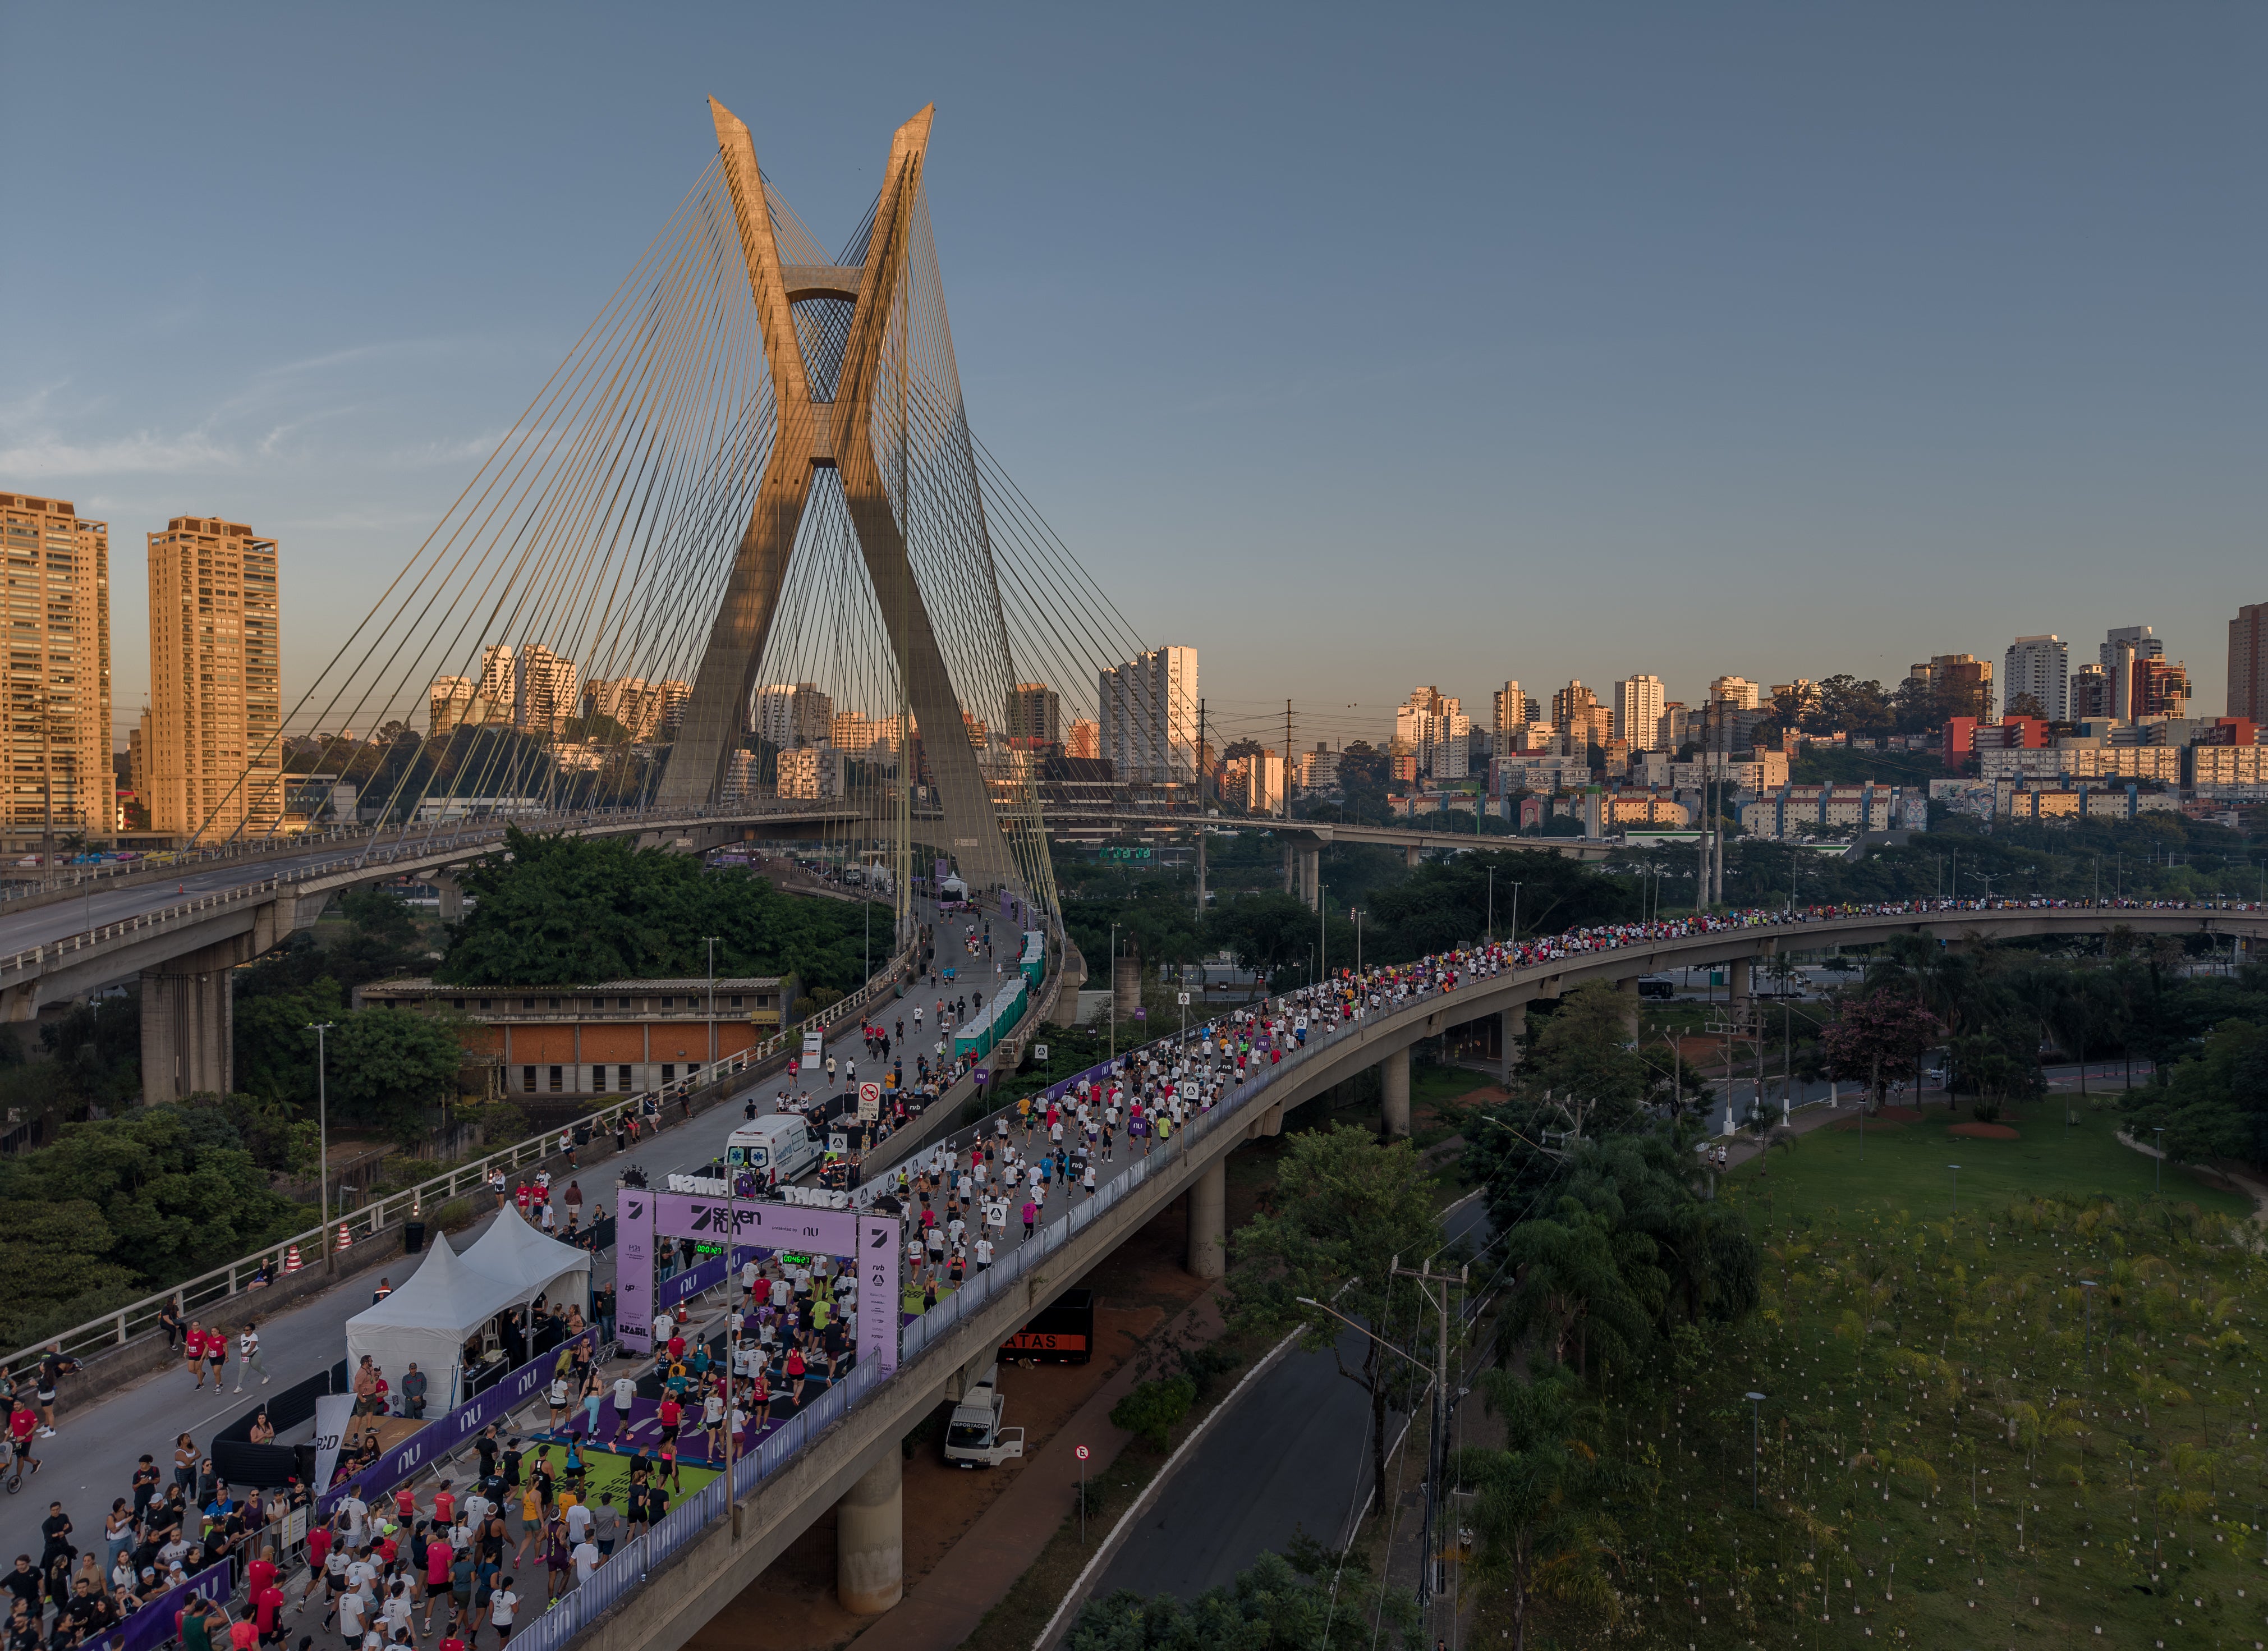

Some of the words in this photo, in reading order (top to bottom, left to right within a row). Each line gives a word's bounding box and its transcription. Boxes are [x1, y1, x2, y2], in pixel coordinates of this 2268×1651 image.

[713, 1207, 761, 1225] seven
[713, 1219, 741, 1235] run
[804, 1227, 819, 1237] nu
[784, 1255, 809, 1264] 00:46:27
[680, 1274, 697, 1295] nu
[619, 1324, 649, 1337] BRASIL
[518, 1368, 536, 1396] nu
[461, 1404, 481, 1432] nu
[316, 1434, 339, 1452] PCD
[398, 1443, 420, 1474] nu
